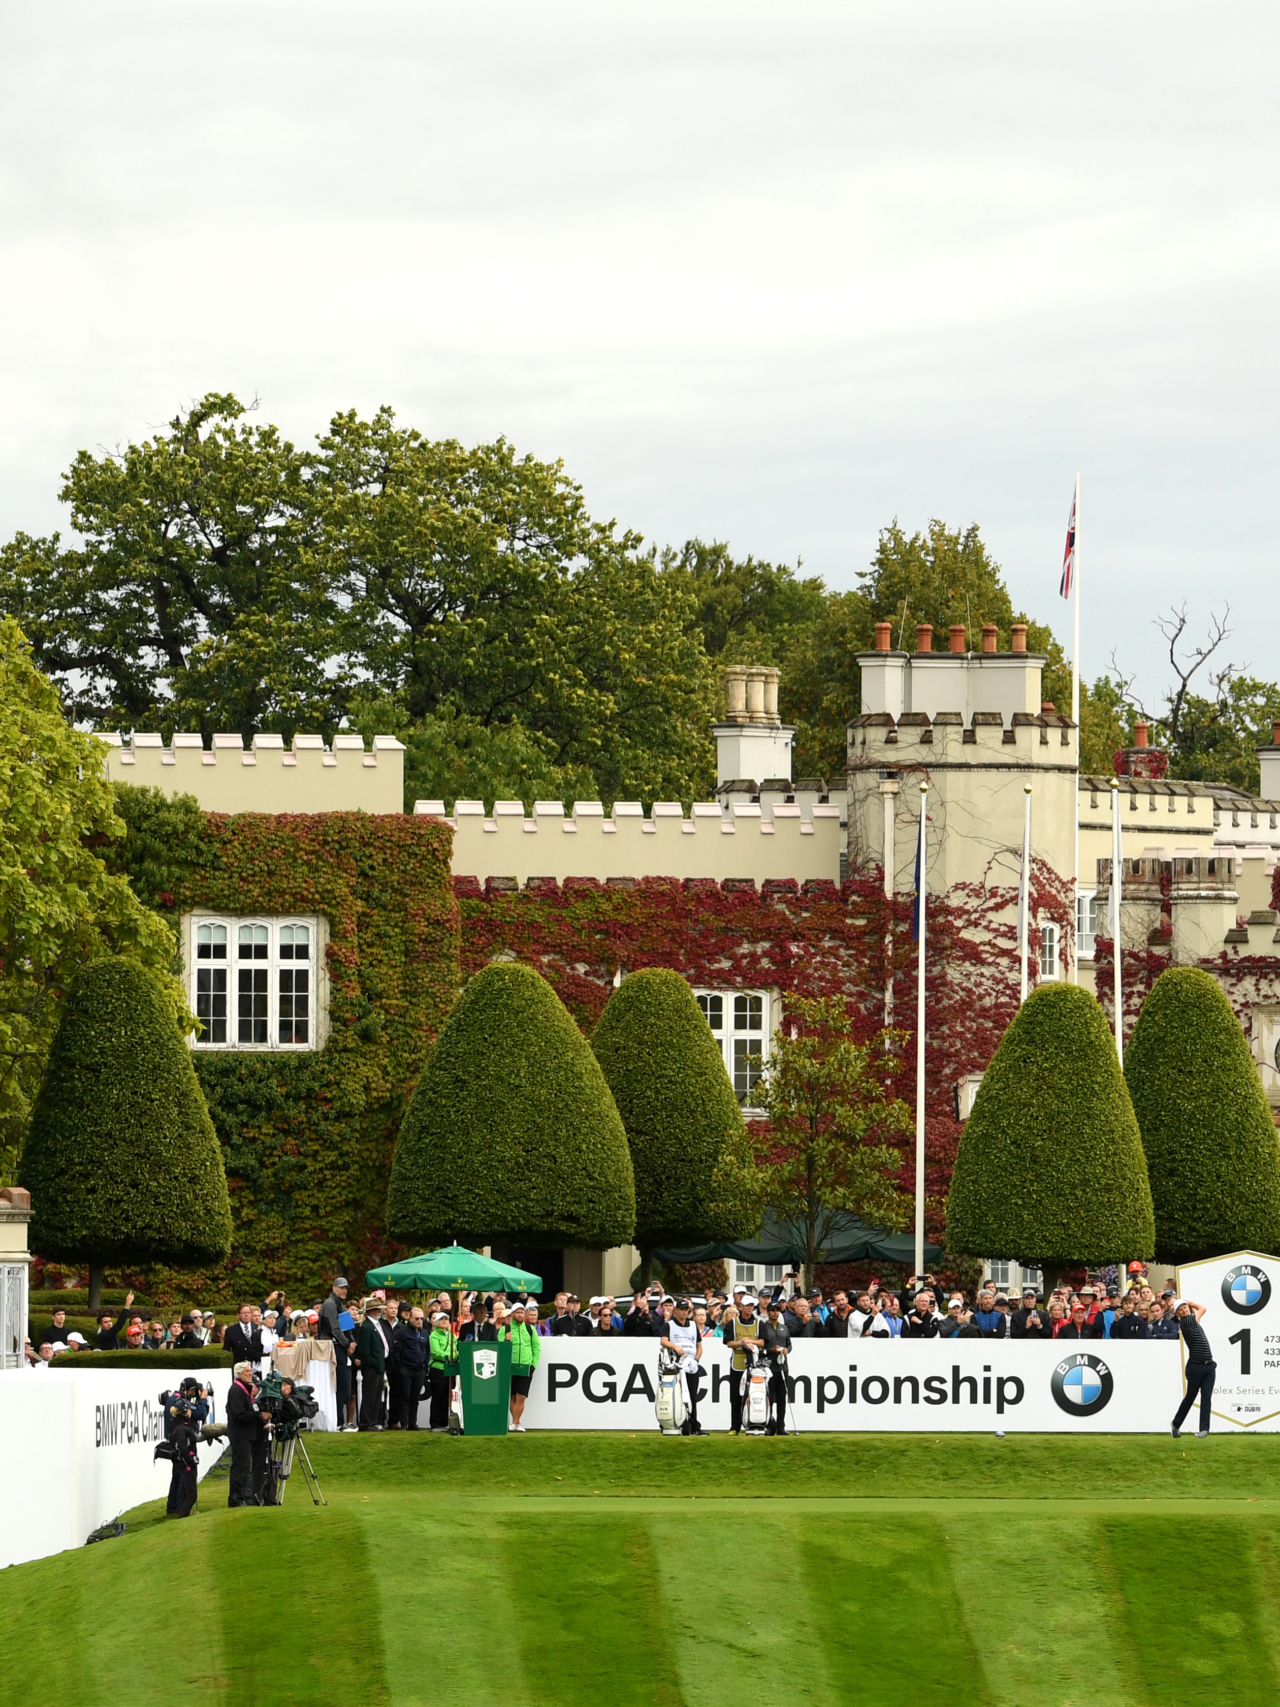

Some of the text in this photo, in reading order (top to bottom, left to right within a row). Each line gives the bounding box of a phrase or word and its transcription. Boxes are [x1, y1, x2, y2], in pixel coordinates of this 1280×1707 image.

[1225, 1266, 1268, 1283] BMW
[1228, 1328, 1251, 1375] 1
[1264, 1348, 1280, 1356] 433
[548, 1362, 656, 1404] PGA
[696, 1362, 1025, 1414] hmpionship
[1212, 1386, 1234, 1395] olex
[1236, 1386, 1265, 1395] Series
[95, 1403, 119, 1448] BMW
[120, 1401, 140, 1445] PGA
